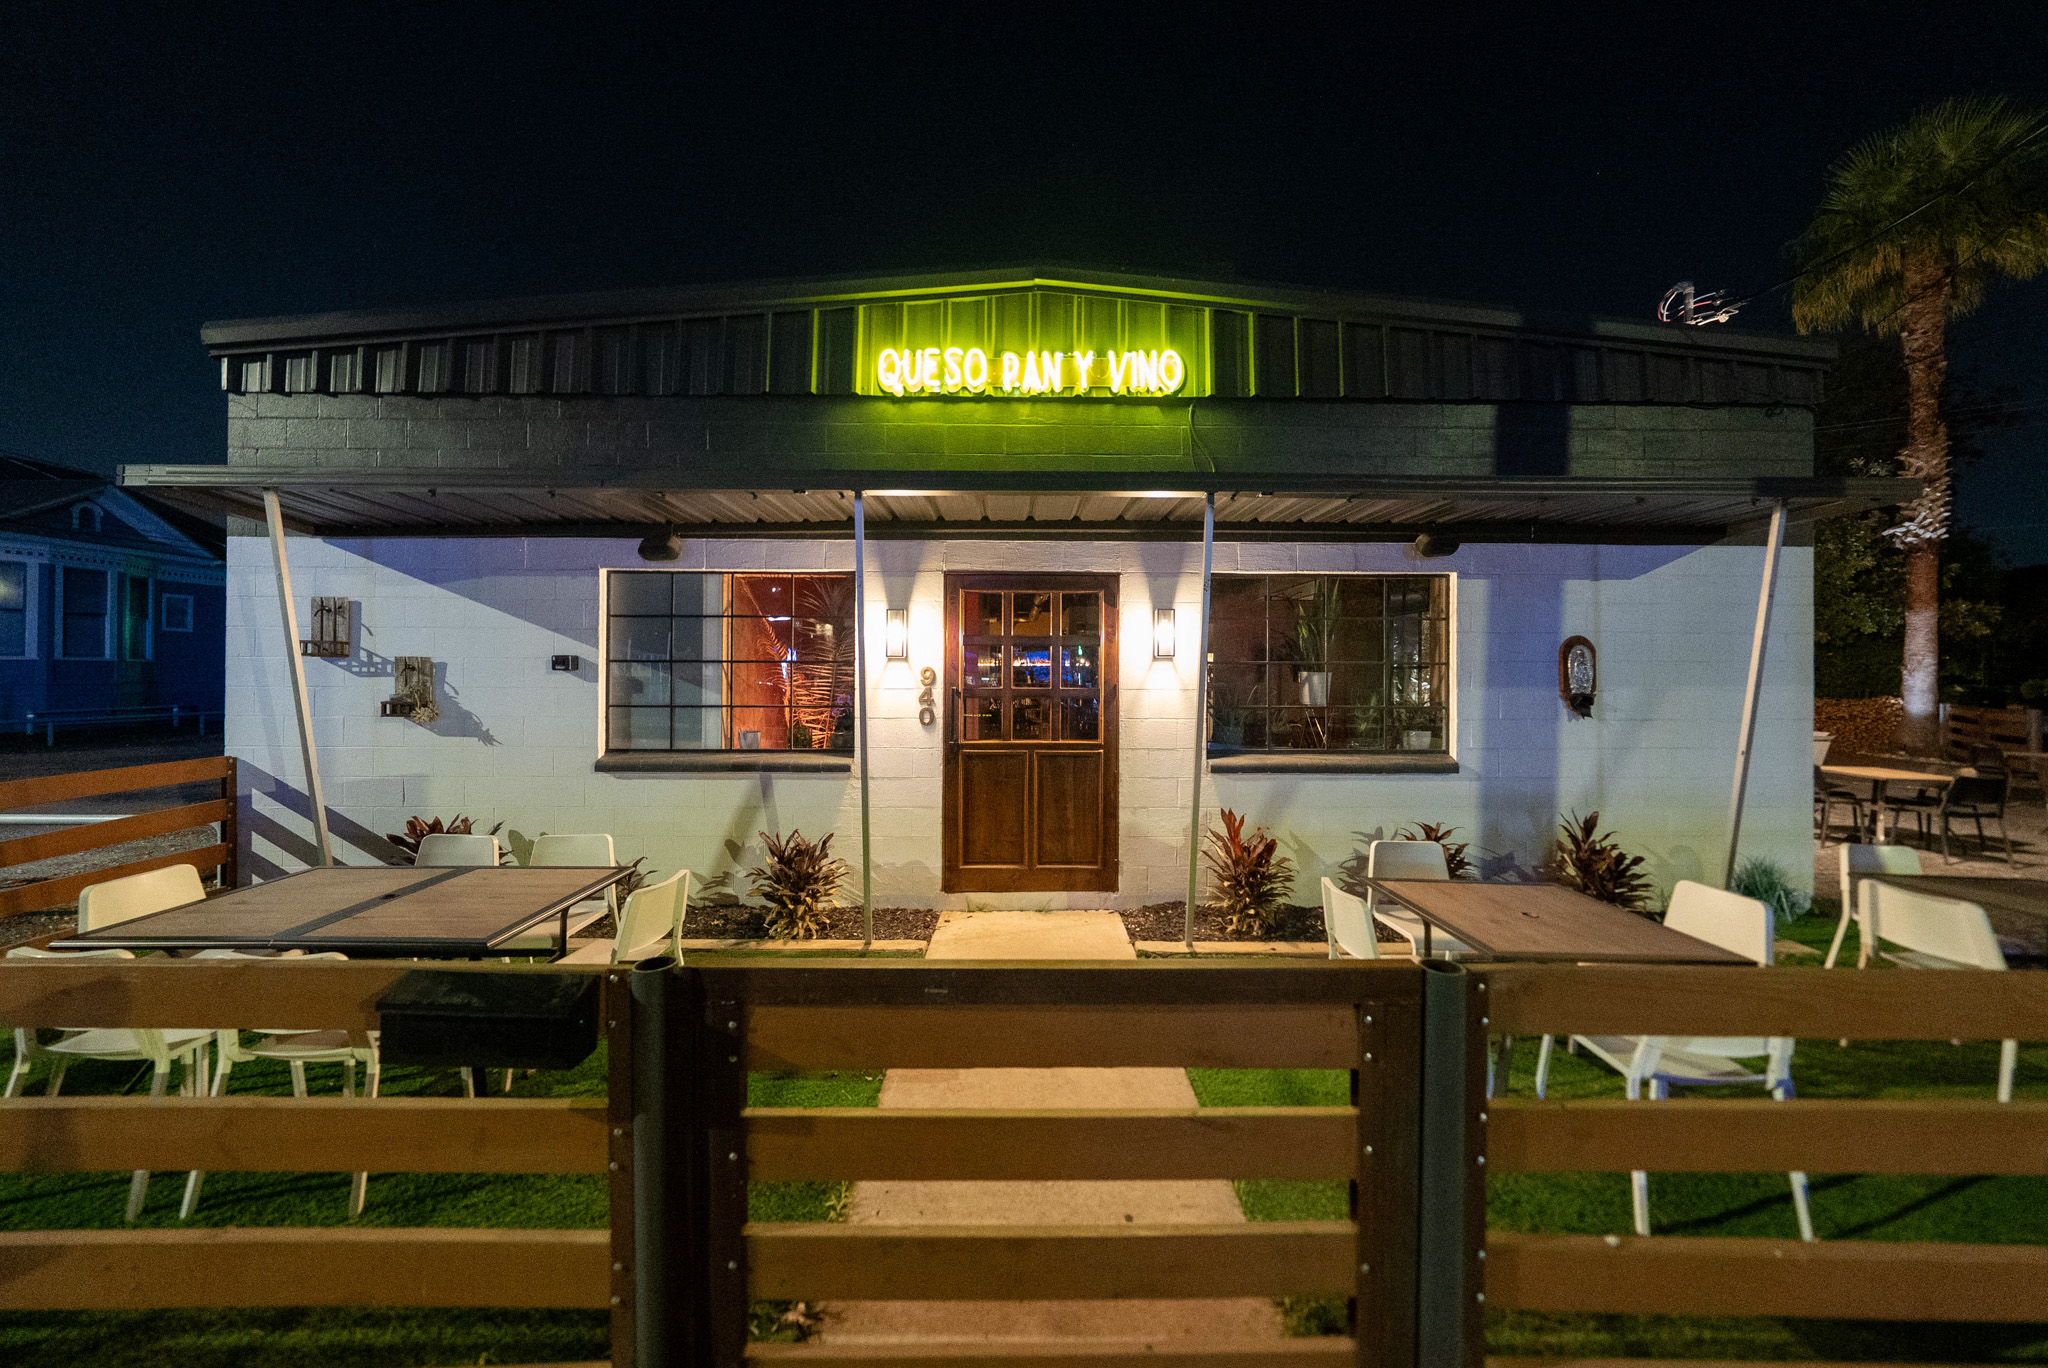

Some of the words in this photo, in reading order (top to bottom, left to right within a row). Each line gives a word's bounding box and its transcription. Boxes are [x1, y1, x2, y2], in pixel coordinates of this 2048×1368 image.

[877, 347, 988, 396] QUESO
[1002, 350, 1063, 393] PAN
[1073, 350, 1095, 393] Y
[1108, 349, 1183, 393] VINO
[918, 666, 935, 726] 940
